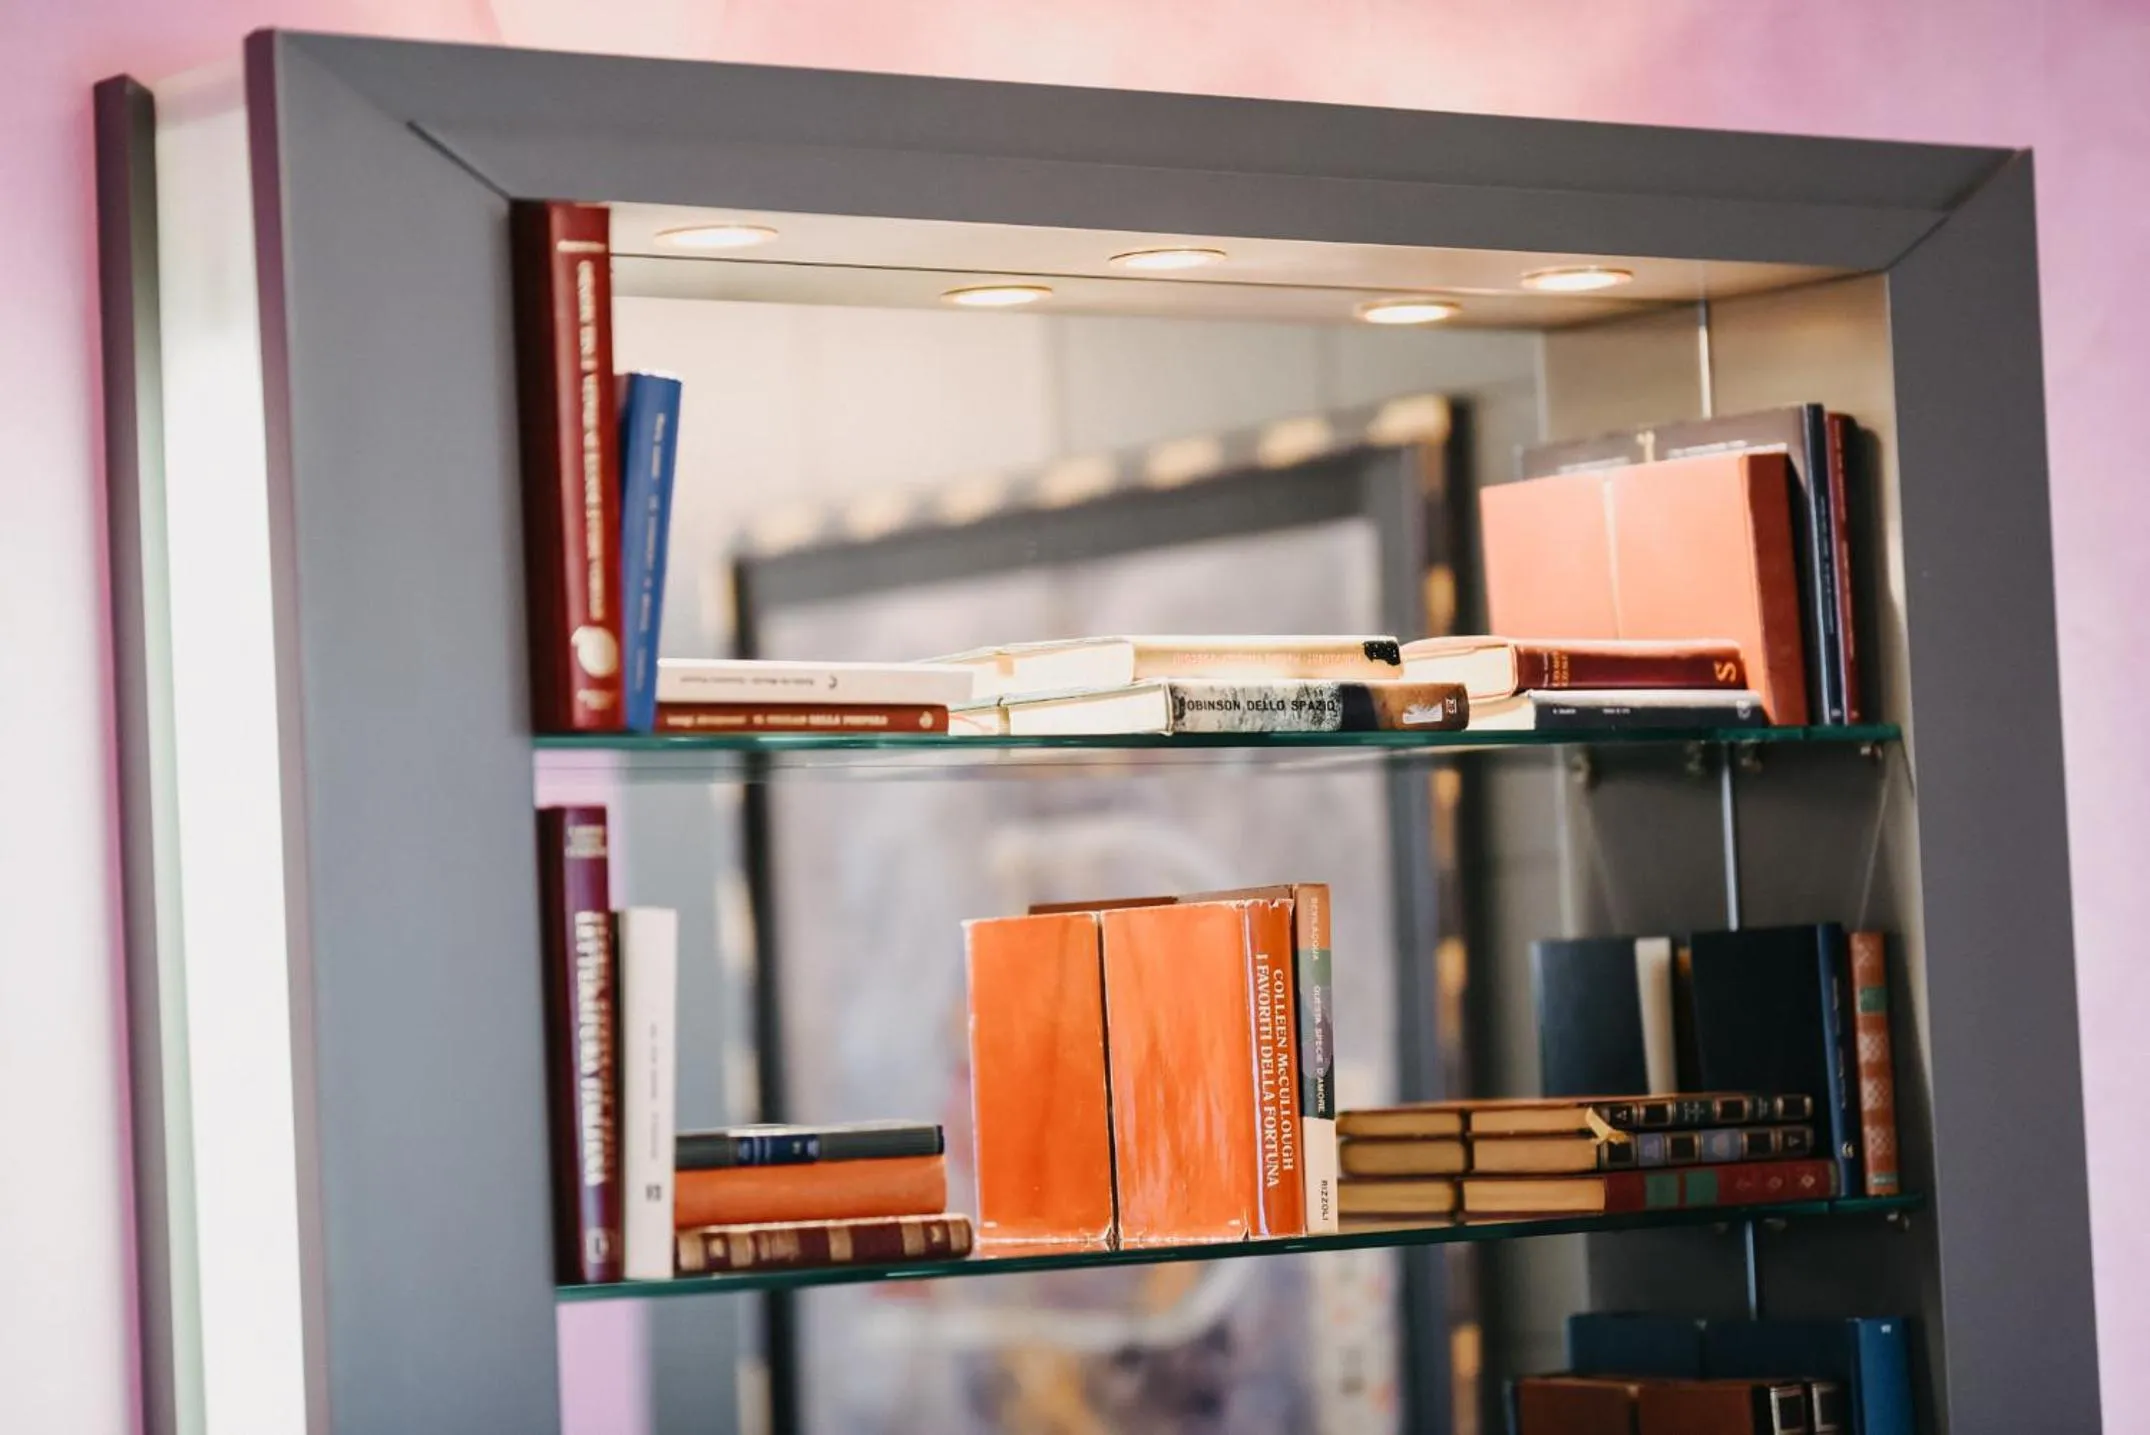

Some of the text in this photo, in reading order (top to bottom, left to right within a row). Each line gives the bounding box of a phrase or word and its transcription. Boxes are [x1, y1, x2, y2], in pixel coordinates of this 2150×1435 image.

[1246, 698, 1286, 711] DELLO
[1290, 699, 1338, 712] SPAZIO
[1256, 966, 1273, 1041] FAVORITI
[1260, 1045, 1275, 1100] DELLA
[1273, 969, 1293, 1170] COLLEEN McCULLOUGH
[1318, 1067, 1326, 1113] D'AMORE
[1263, 1106, 1280, 1188] FORTUNA
[1321, 1180, 1330, 1221] RIZZOLI
